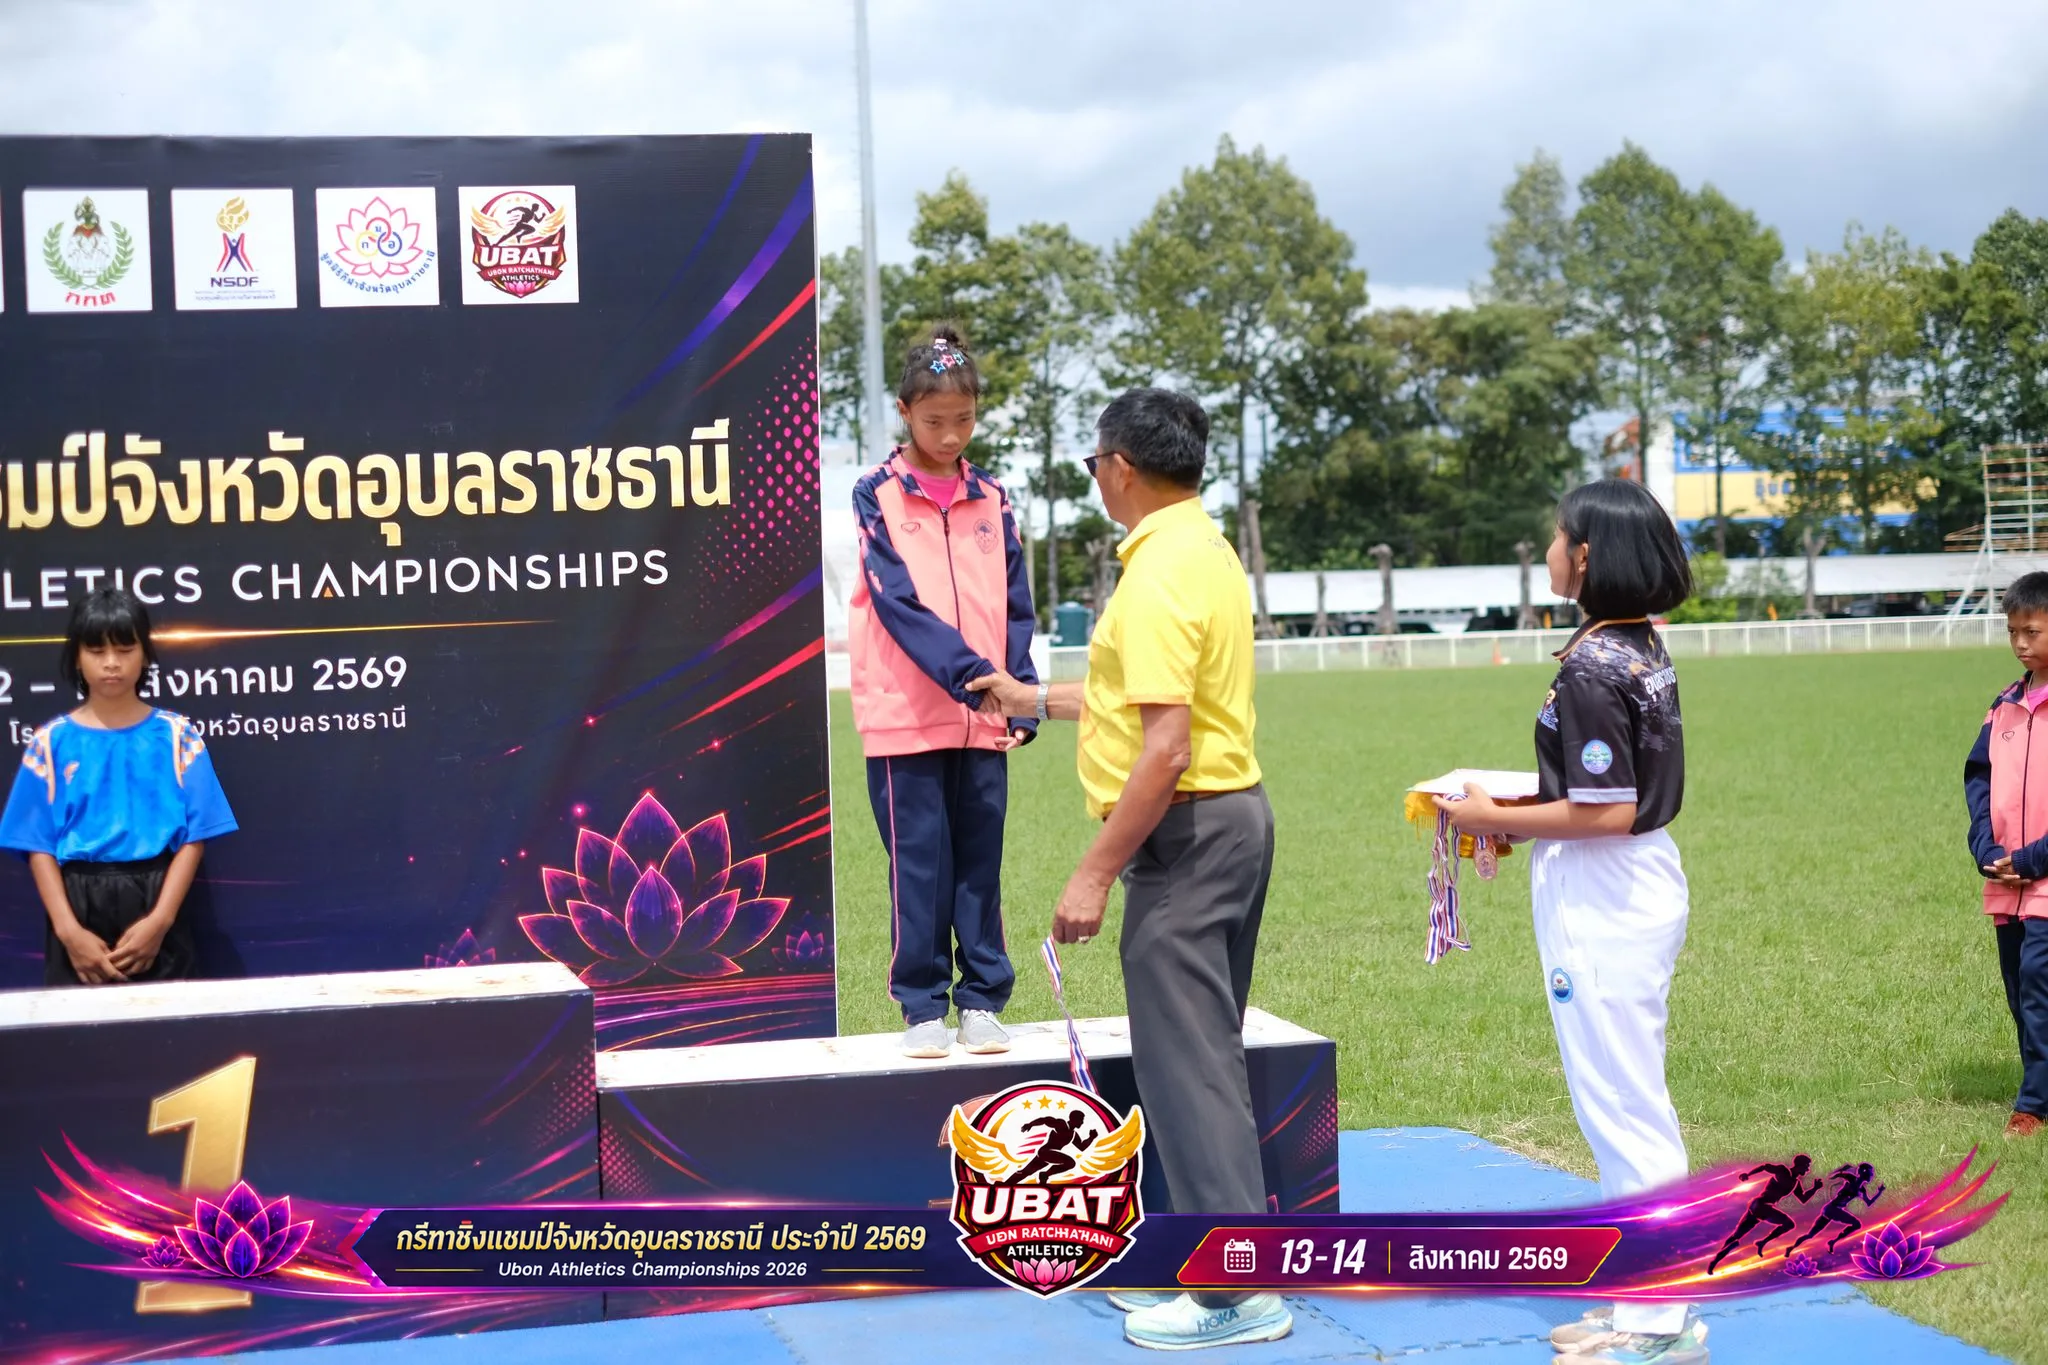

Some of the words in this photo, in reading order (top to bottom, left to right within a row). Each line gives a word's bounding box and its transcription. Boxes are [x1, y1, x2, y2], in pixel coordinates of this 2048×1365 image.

[479, 245, 559, 267] UBAT
[210, 276, 260, 288] NSDF
[487, 268, 507, 278] UBON
[501, 274, 540, 282] ATHLETICS
[0, 417, 731, 547] มป์จังหวัดอุบลราชธานี
[231, 549, 669, 601] CHAMPIONSHIPS
[312, 655, 408, 692] 2569
[135, 1055, 257, 1313] 1
[1196, 1307, 1240, 1334] HOKA
